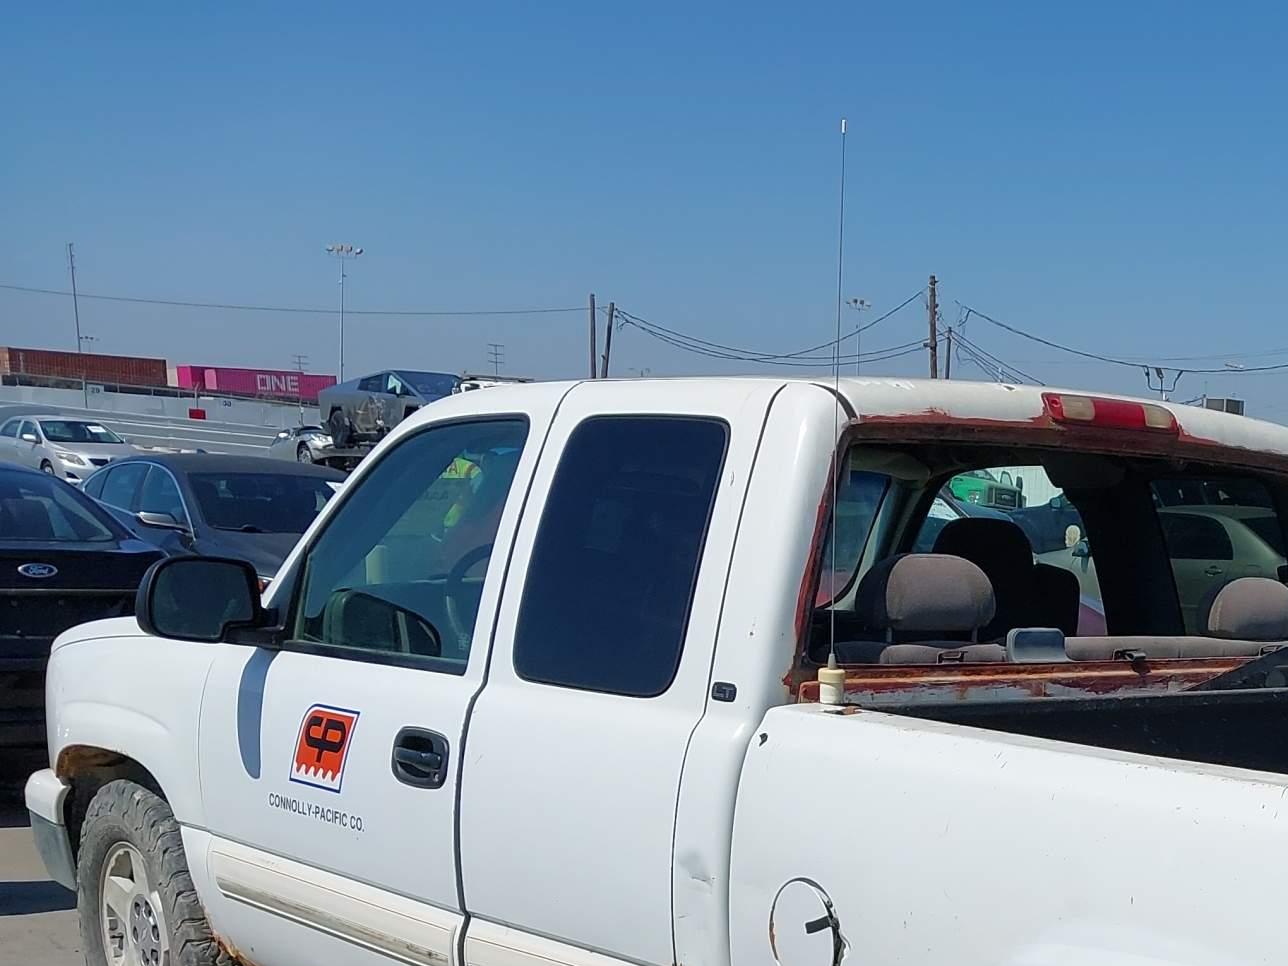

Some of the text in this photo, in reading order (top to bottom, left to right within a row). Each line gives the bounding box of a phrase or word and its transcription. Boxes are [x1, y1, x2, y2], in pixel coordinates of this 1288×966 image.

[257, 374, 299, 392] ONE
[268, 792, 366, 833] CONNOLLY-PACIFIC CO.
